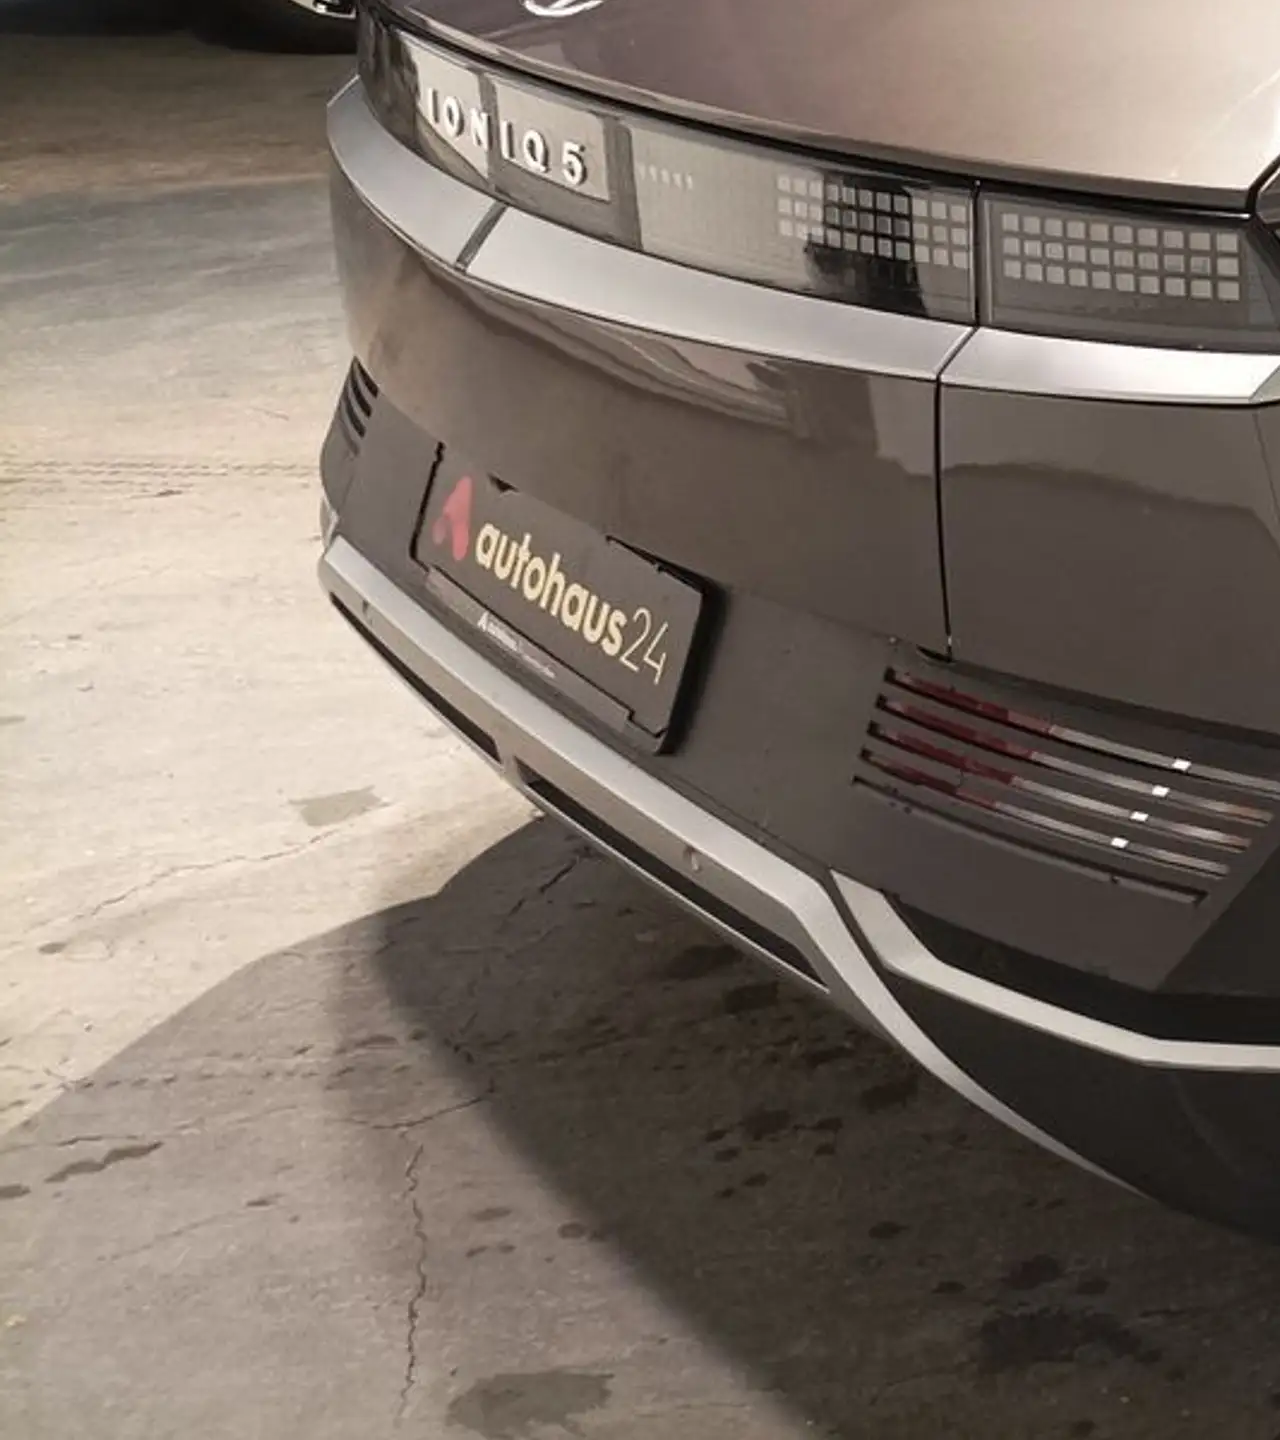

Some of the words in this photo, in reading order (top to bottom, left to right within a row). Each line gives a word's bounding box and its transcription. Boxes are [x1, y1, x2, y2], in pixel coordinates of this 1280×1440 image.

[428, 87, 549, 173] IONIQ
[562, 140, 588, 186] 5
[475, 522, 669, 686] autohaus24
